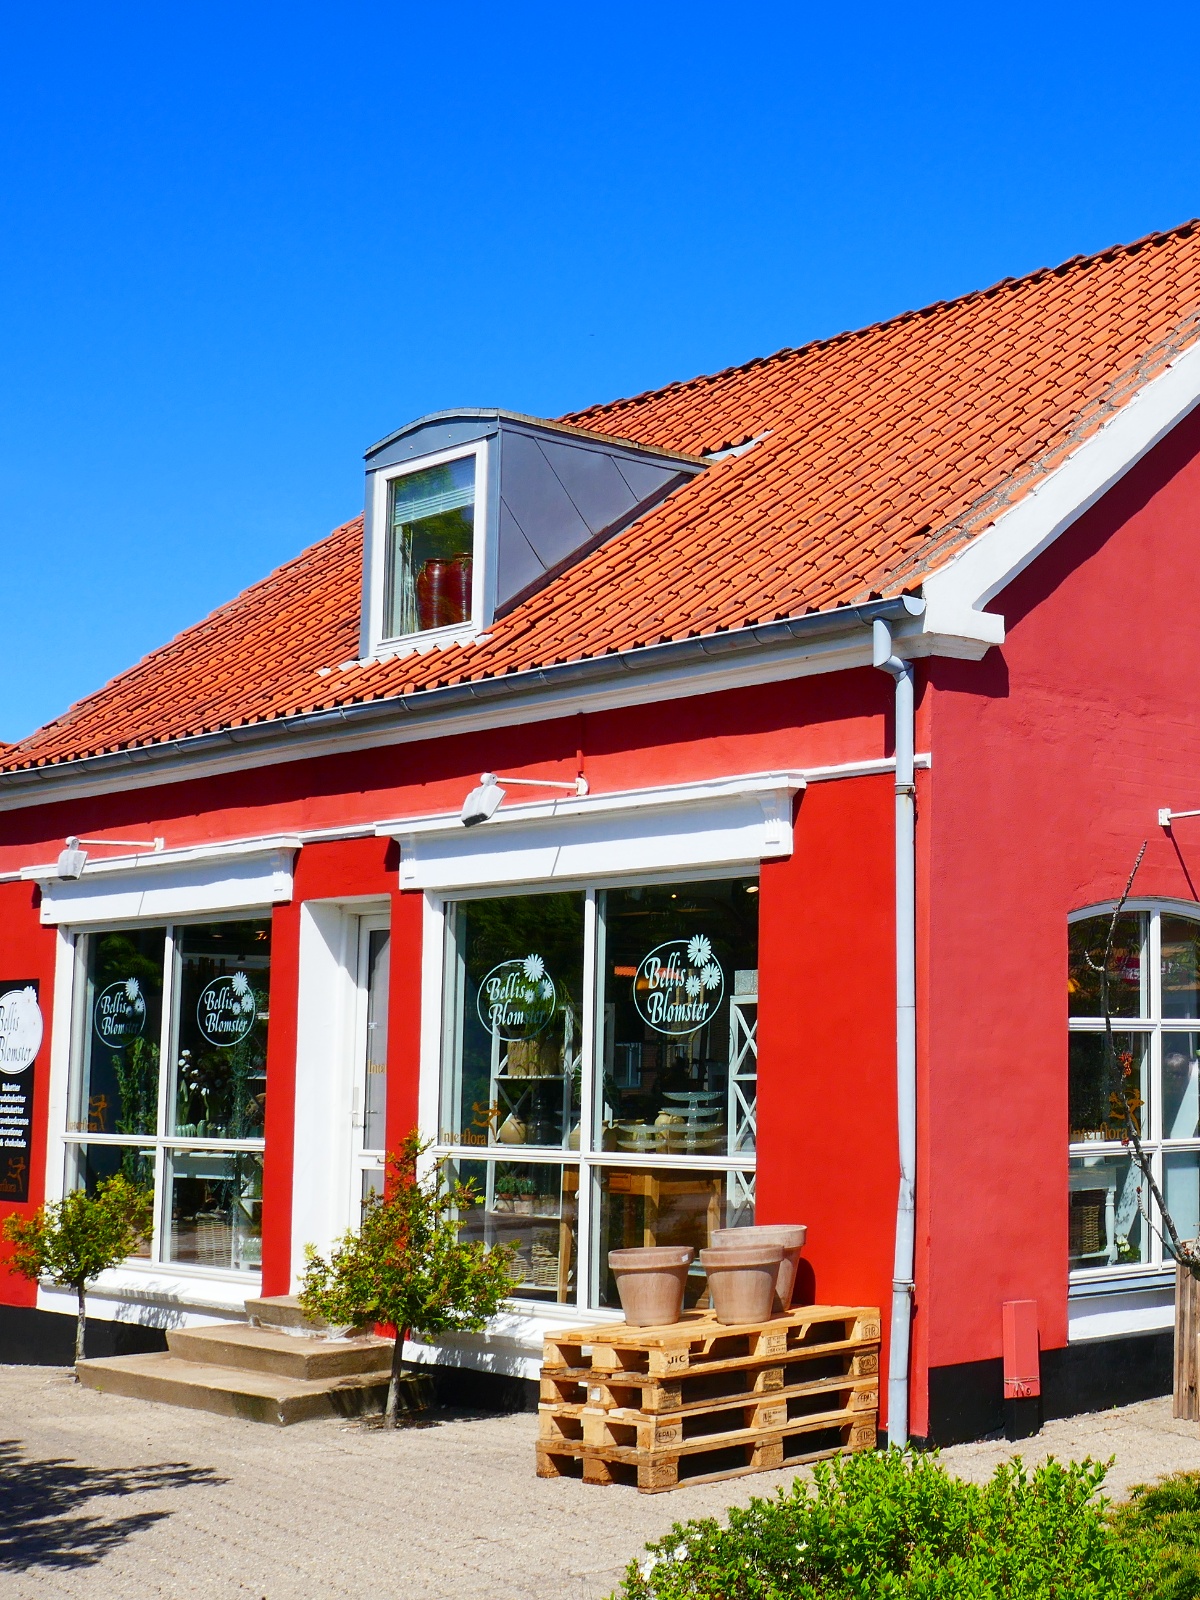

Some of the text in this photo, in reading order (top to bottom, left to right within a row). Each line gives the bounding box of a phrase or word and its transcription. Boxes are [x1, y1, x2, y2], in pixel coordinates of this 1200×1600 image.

[645, 951, 686, 990] Bellis
[204, 986, 234, 1011] Bellis
[486, 971, 526, 1001] Bellis
[100, 991, 127, 1015] Bellis
[488, 999, 545, 1026] Blomster
[647, 988, 710, 1024] Blomster
[101, 1014, 139, 1036] Blomster
[205, 1010, 248, 1034] Blomster
[440, 1126, 487, 1146] Interflora
